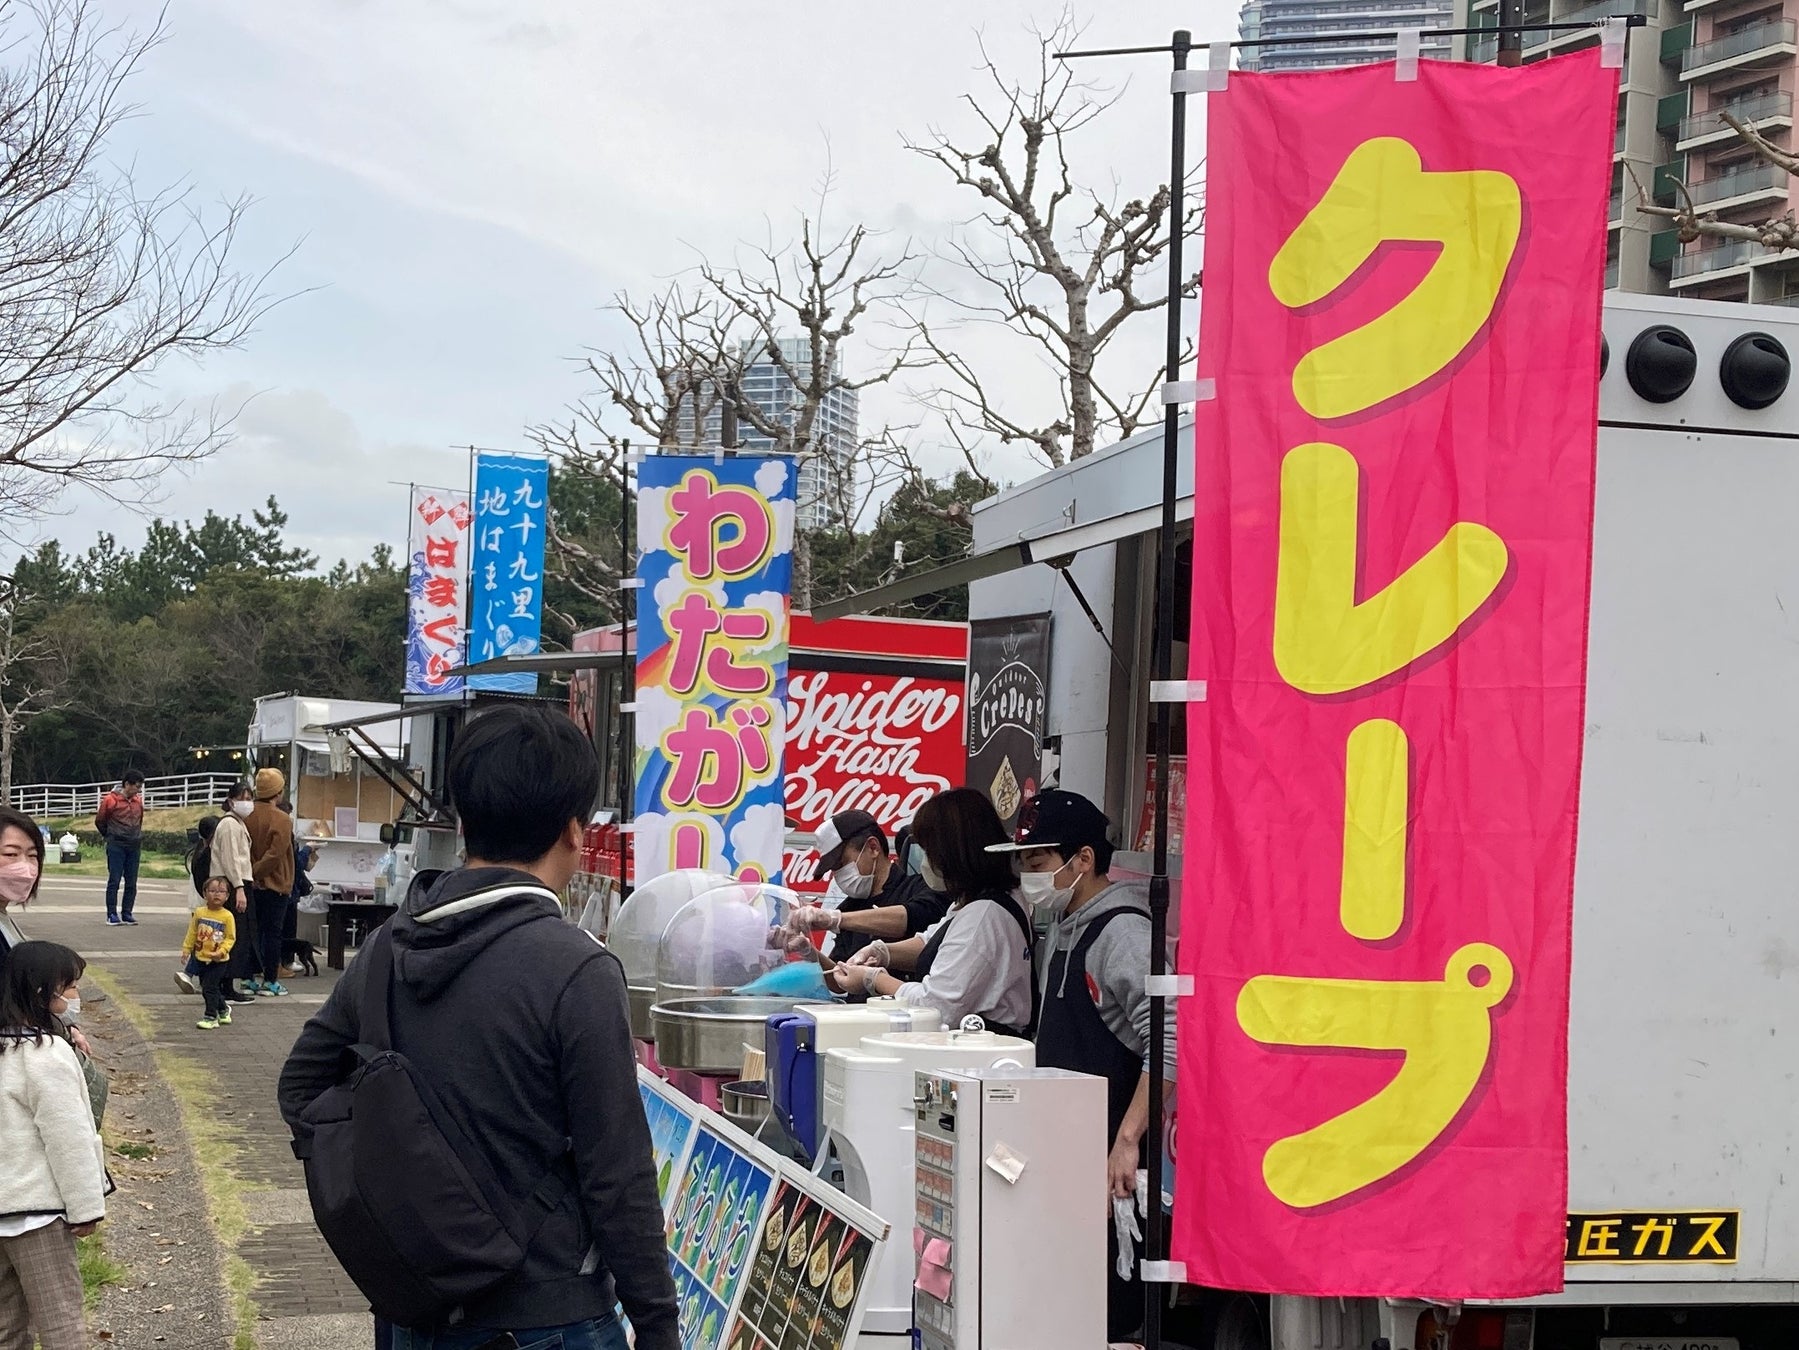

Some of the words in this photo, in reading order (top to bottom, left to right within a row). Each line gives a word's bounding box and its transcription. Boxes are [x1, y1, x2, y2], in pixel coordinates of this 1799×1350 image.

[424, 535, 458, 685] はまぐり
[479, 486, 510, 660] 地はまぐり
[508, 478, 542, 620] 九十九里
[786, 672, 960, 750] Spider
[1236, 136, 1523, 1209] クレープ
[801, 732, 926, 779] Flash
[1564, 1217, 1727, 1257] 圧ガス
